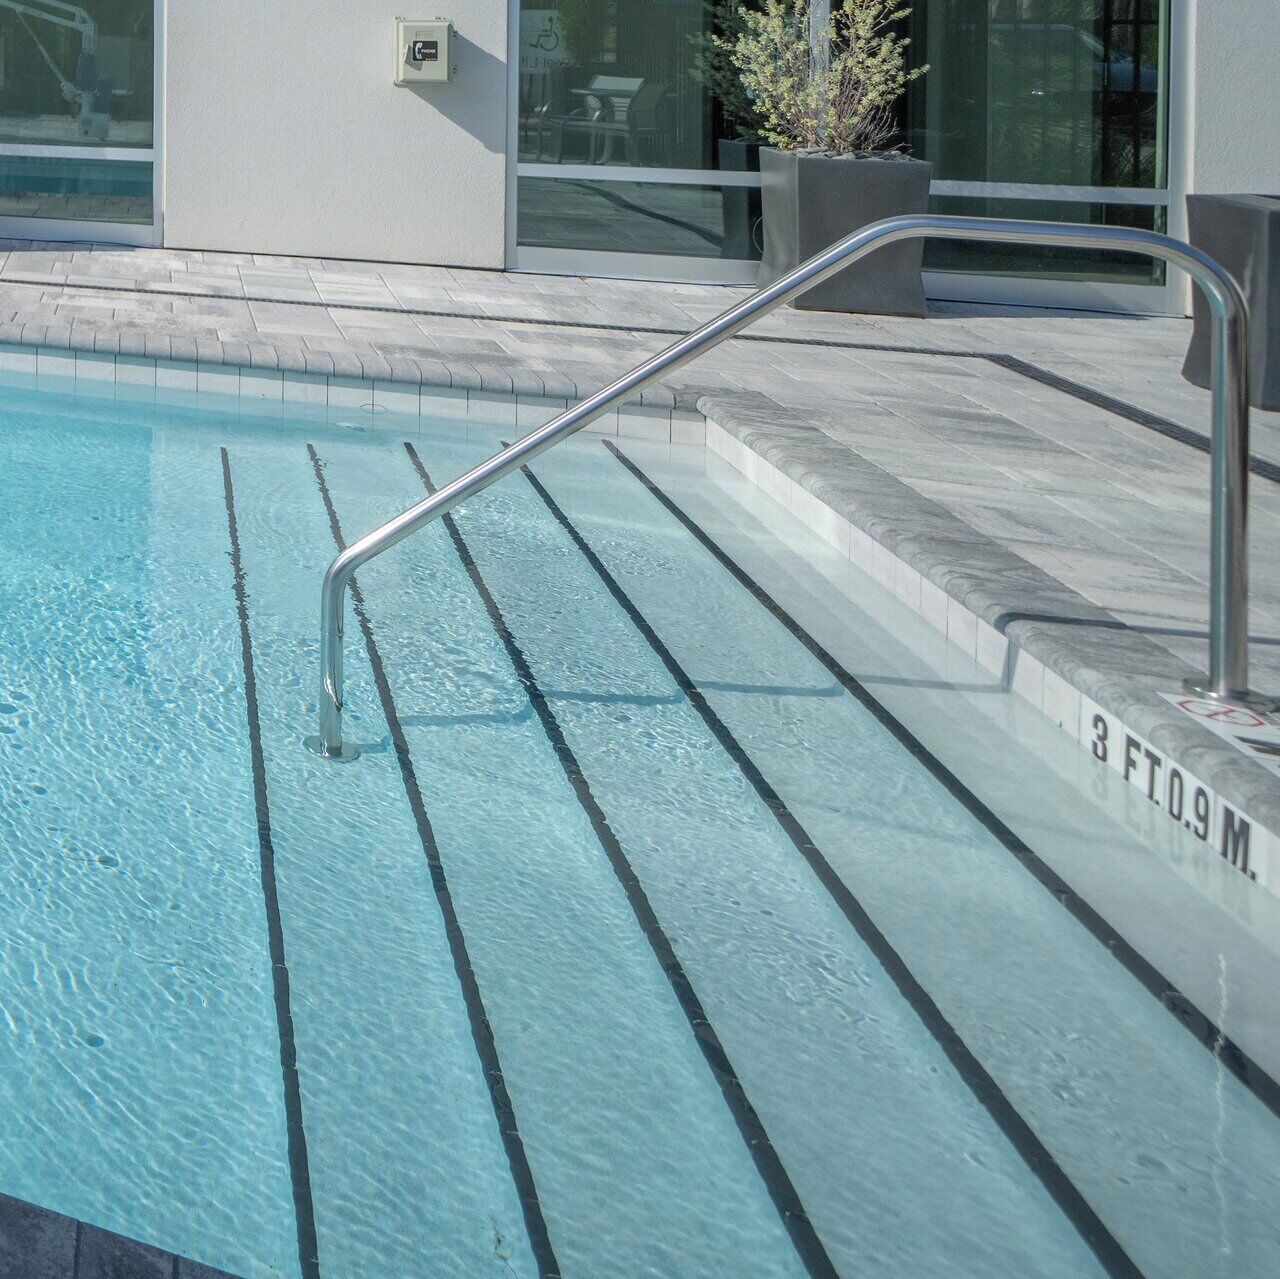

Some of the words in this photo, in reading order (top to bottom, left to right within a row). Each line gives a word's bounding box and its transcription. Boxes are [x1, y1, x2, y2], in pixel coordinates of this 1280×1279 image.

[1091, 713, 1108, 763] 3
[1168, 767, 1209, 842] 0.9
[1221, 804, 1256, 881] M.
